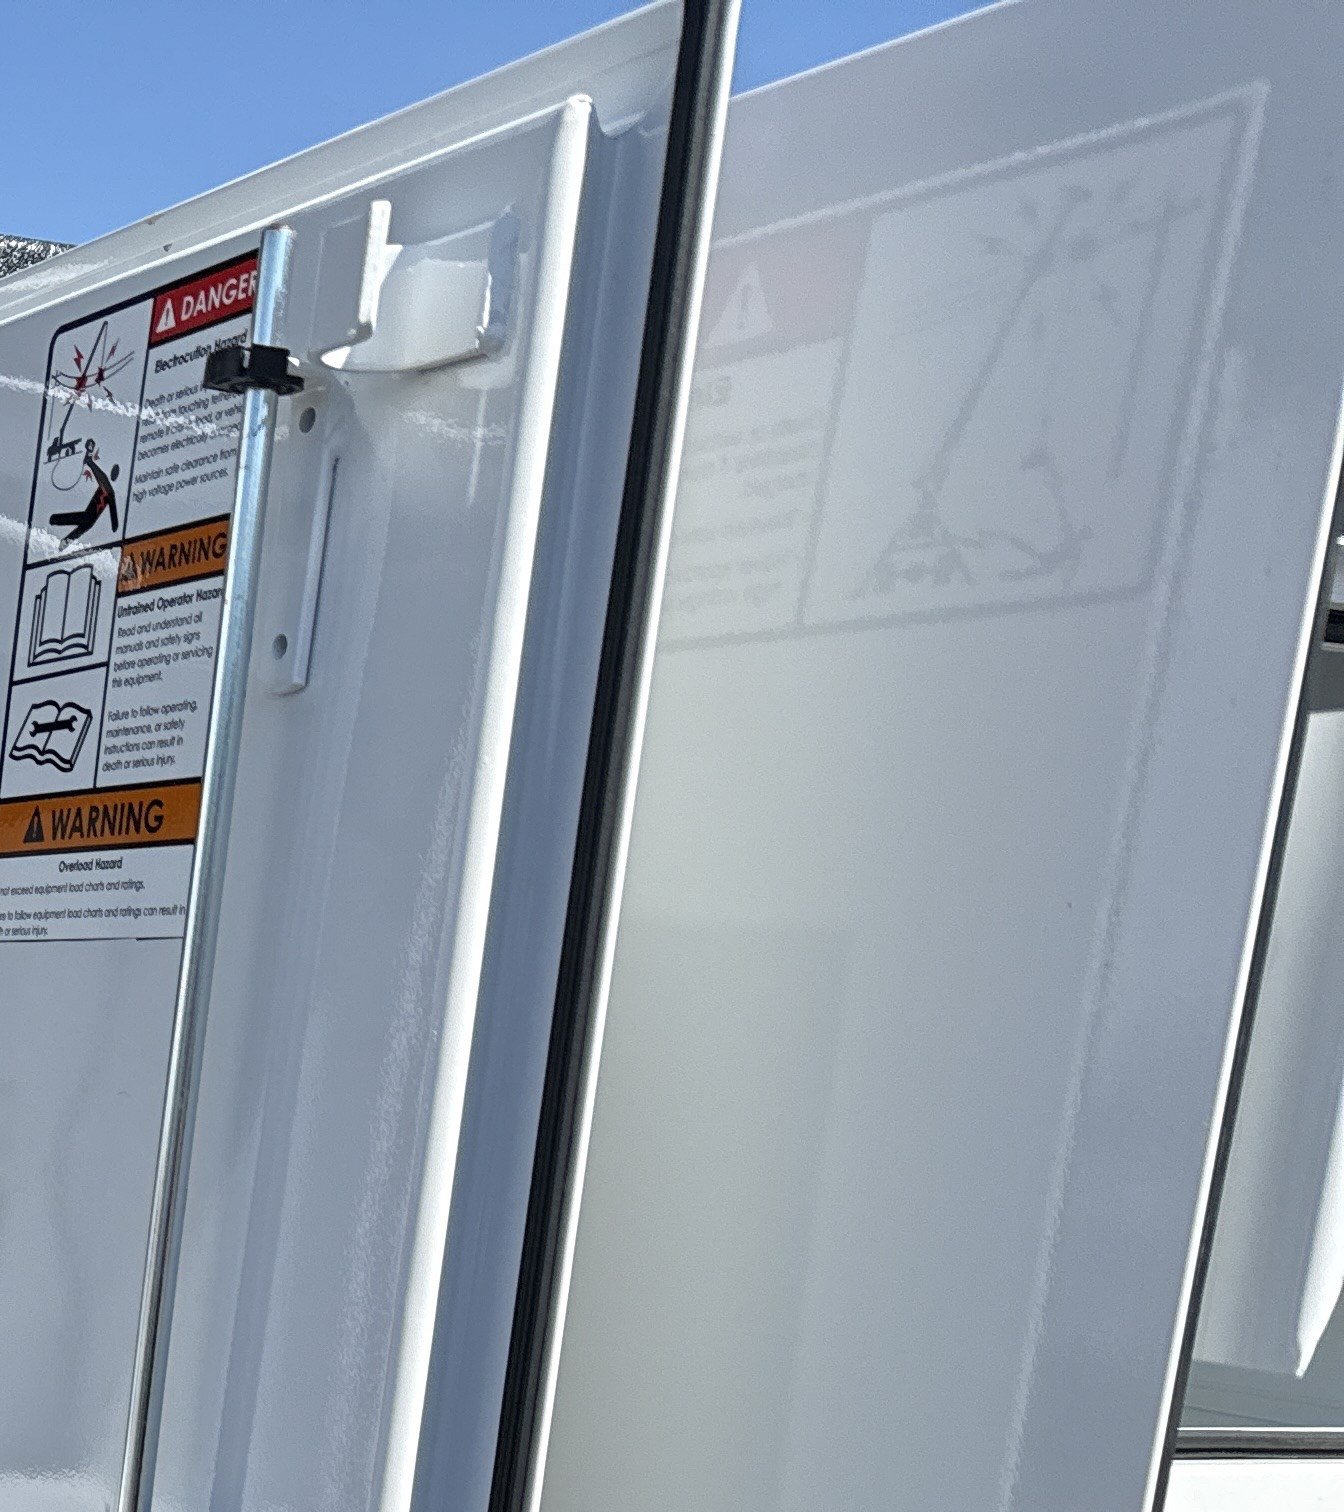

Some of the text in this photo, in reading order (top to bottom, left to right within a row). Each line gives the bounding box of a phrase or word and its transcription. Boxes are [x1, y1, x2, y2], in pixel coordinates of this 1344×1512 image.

[180, 270, 257, 321] DANGER
[155, 346, 212, 373] Electrocution
[181, 452, 218, 472] clearance
[140, 532, 227, 575] WARNING
[117, 586, 223, 619] Untrained Operator Hazar
[117, 626, 135, 638] Read
[136, 622, 151, 635] and
[152, 613, 192, 631] understand
[115, 629, 201, 655] manuals and safety signs
[113, 657, 136, 672] before
[137, 651, 171, 669] operating
[172, 651, 180, 662] or
[111, 675, 123, 688] this
[108, 708, 130, 723] Failure
[130, 707, 139, 718] to
[139, 703, 160, 717] follow
[105, 717, 185, 740] maintenance, or safety
[103, 734, 184, 755] instructions can result in
[102, 759, 123, 773] death
[123, 758, 131, 770] or
[132, 755, 155, 768] serious
[51, 798, 164, 841] WARNING
[58, 856, 123, 873] Overload Hazard
[0, 885, 10, 896] not
[10, 884, 34, 896] exceed
[34, 882, 67, 896] equipment
[68, 881, 83, 893] load
[84, 880, 105, 892] charts
[106, 879, 119, 891] and
[120, 878, 145, 892] ratings.
[7, 910, 14, 921] to
[14, 909, 31, 921] follow
[32, 908, 66, 922] equipment
[67, 907, 82, 919] load
[83, 907, 103, 919] charts
[104, 906, 118, 918] and
[119, 905, 143, 919] ratings
[143, 906, 158, 916] can
[159, 904, 178, 916] result
[4, 927, 11, 937] or
[12, 926, 31, 937] serious
